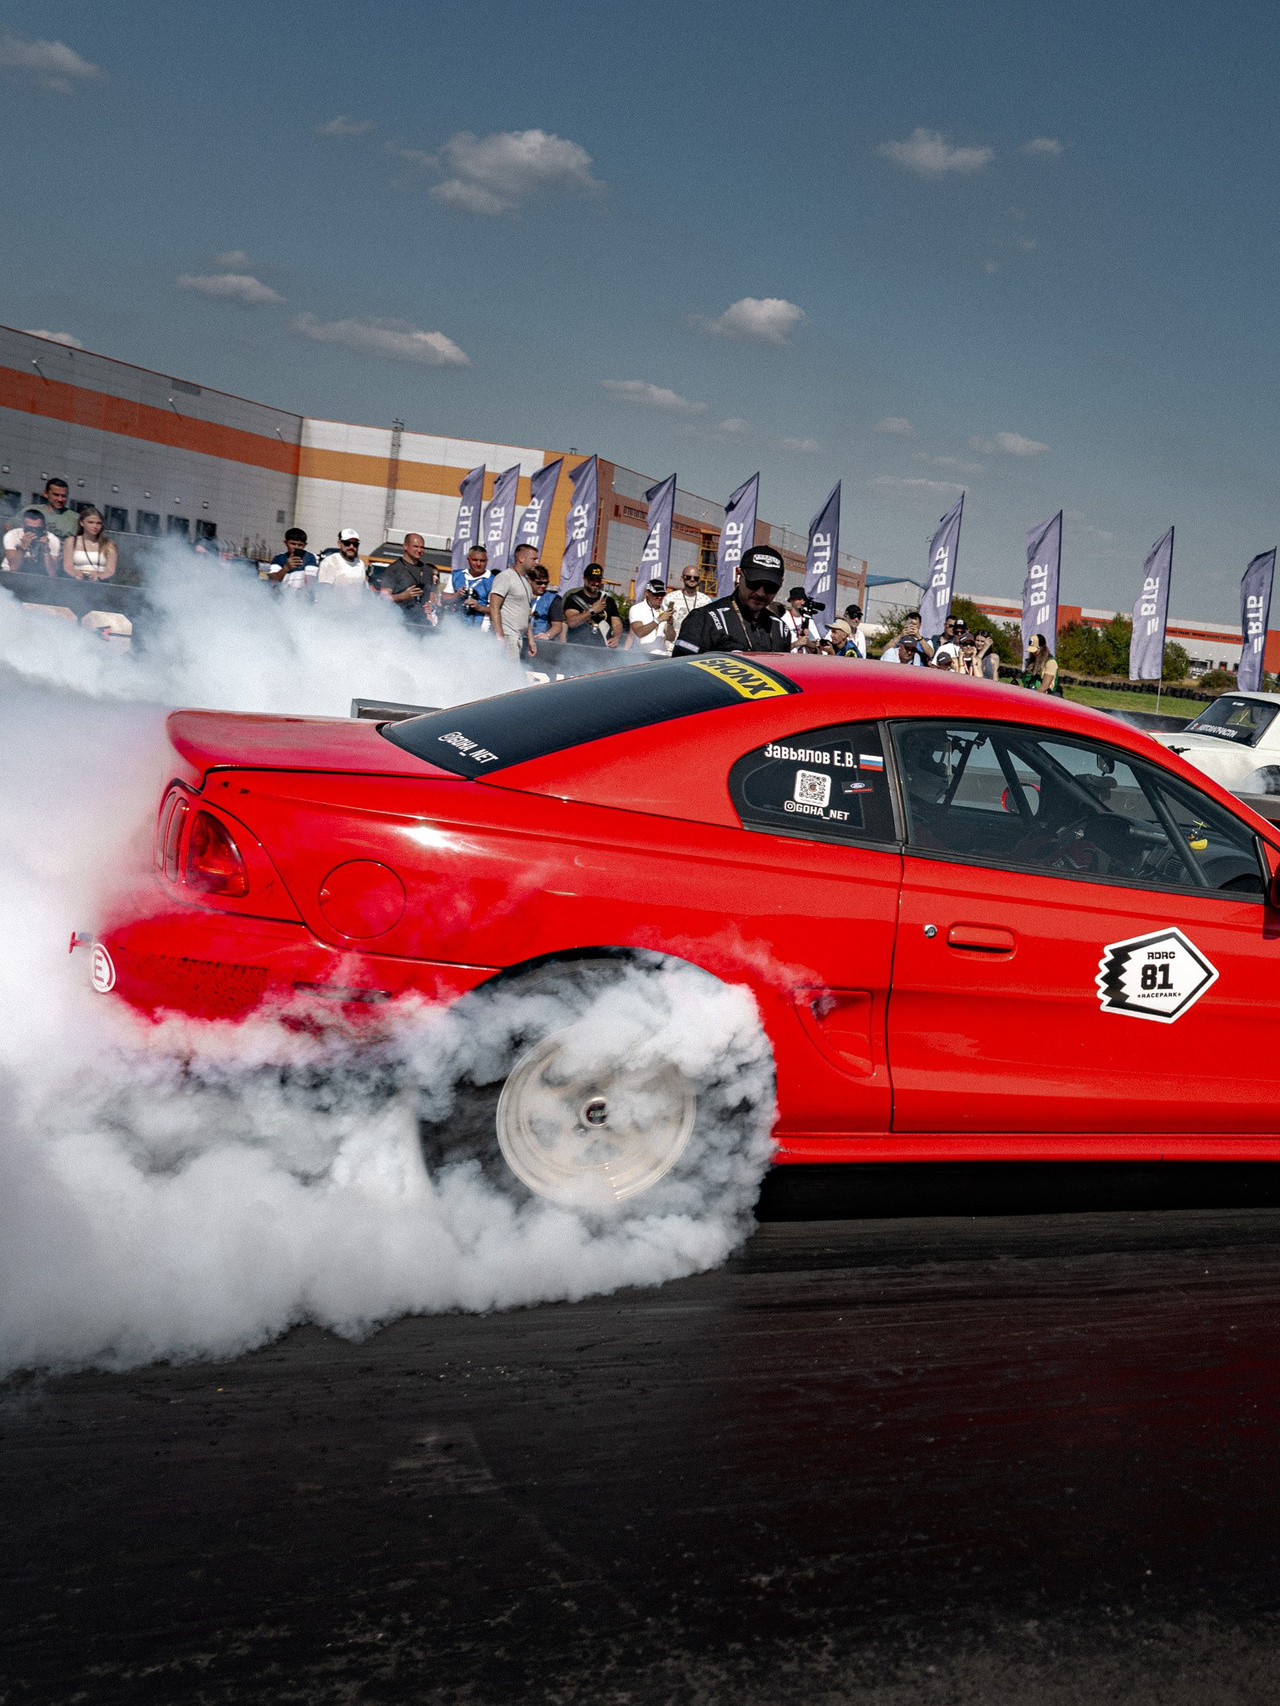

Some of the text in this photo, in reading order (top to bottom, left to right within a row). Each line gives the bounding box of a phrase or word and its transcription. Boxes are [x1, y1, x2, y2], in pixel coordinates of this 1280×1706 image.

[699, 660, 776, 695] SHONX
[833, 750, 857, 768] Е.В.
[1147, 951, 1176, 960] RDRC
[1140, 963, 1174, 990] 81
